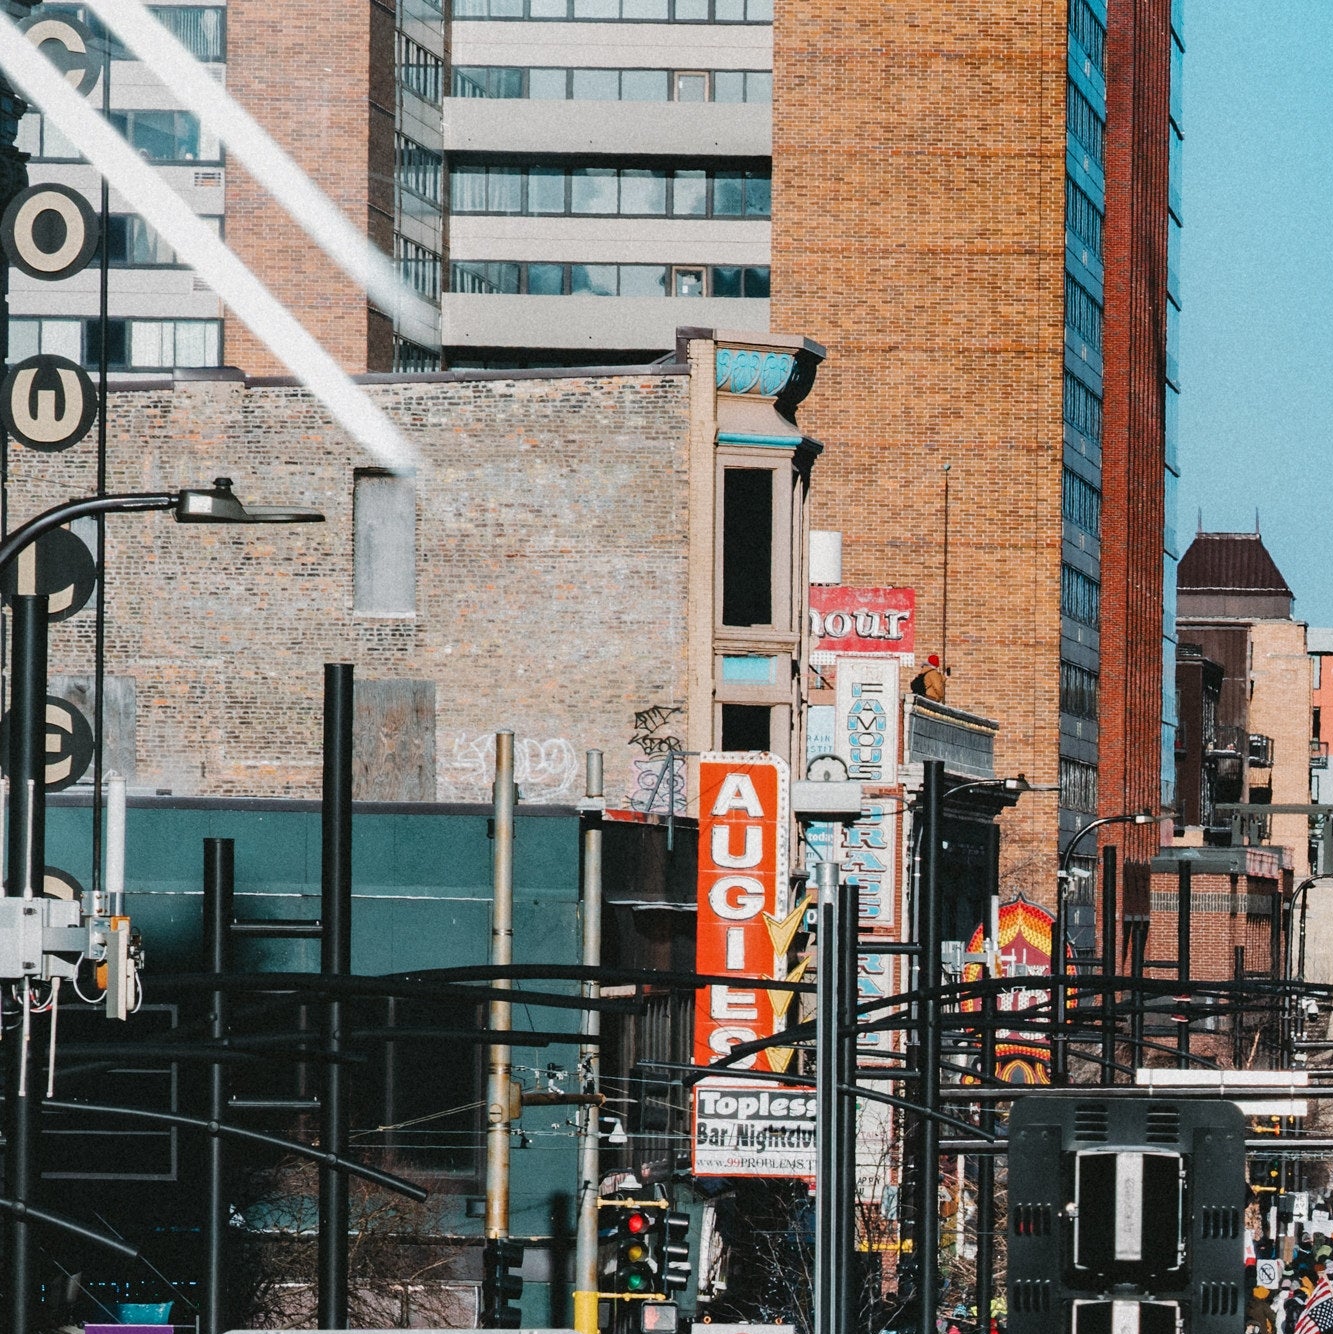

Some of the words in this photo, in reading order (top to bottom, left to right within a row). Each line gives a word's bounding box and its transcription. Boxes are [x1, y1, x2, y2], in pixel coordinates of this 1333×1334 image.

[847, 680, 886, 783] FAMOUS
[697, 1123, 818, 1153] Bar/Nightclu
[696, 1156, 818, 1174] www.99PROBLEMS.T
